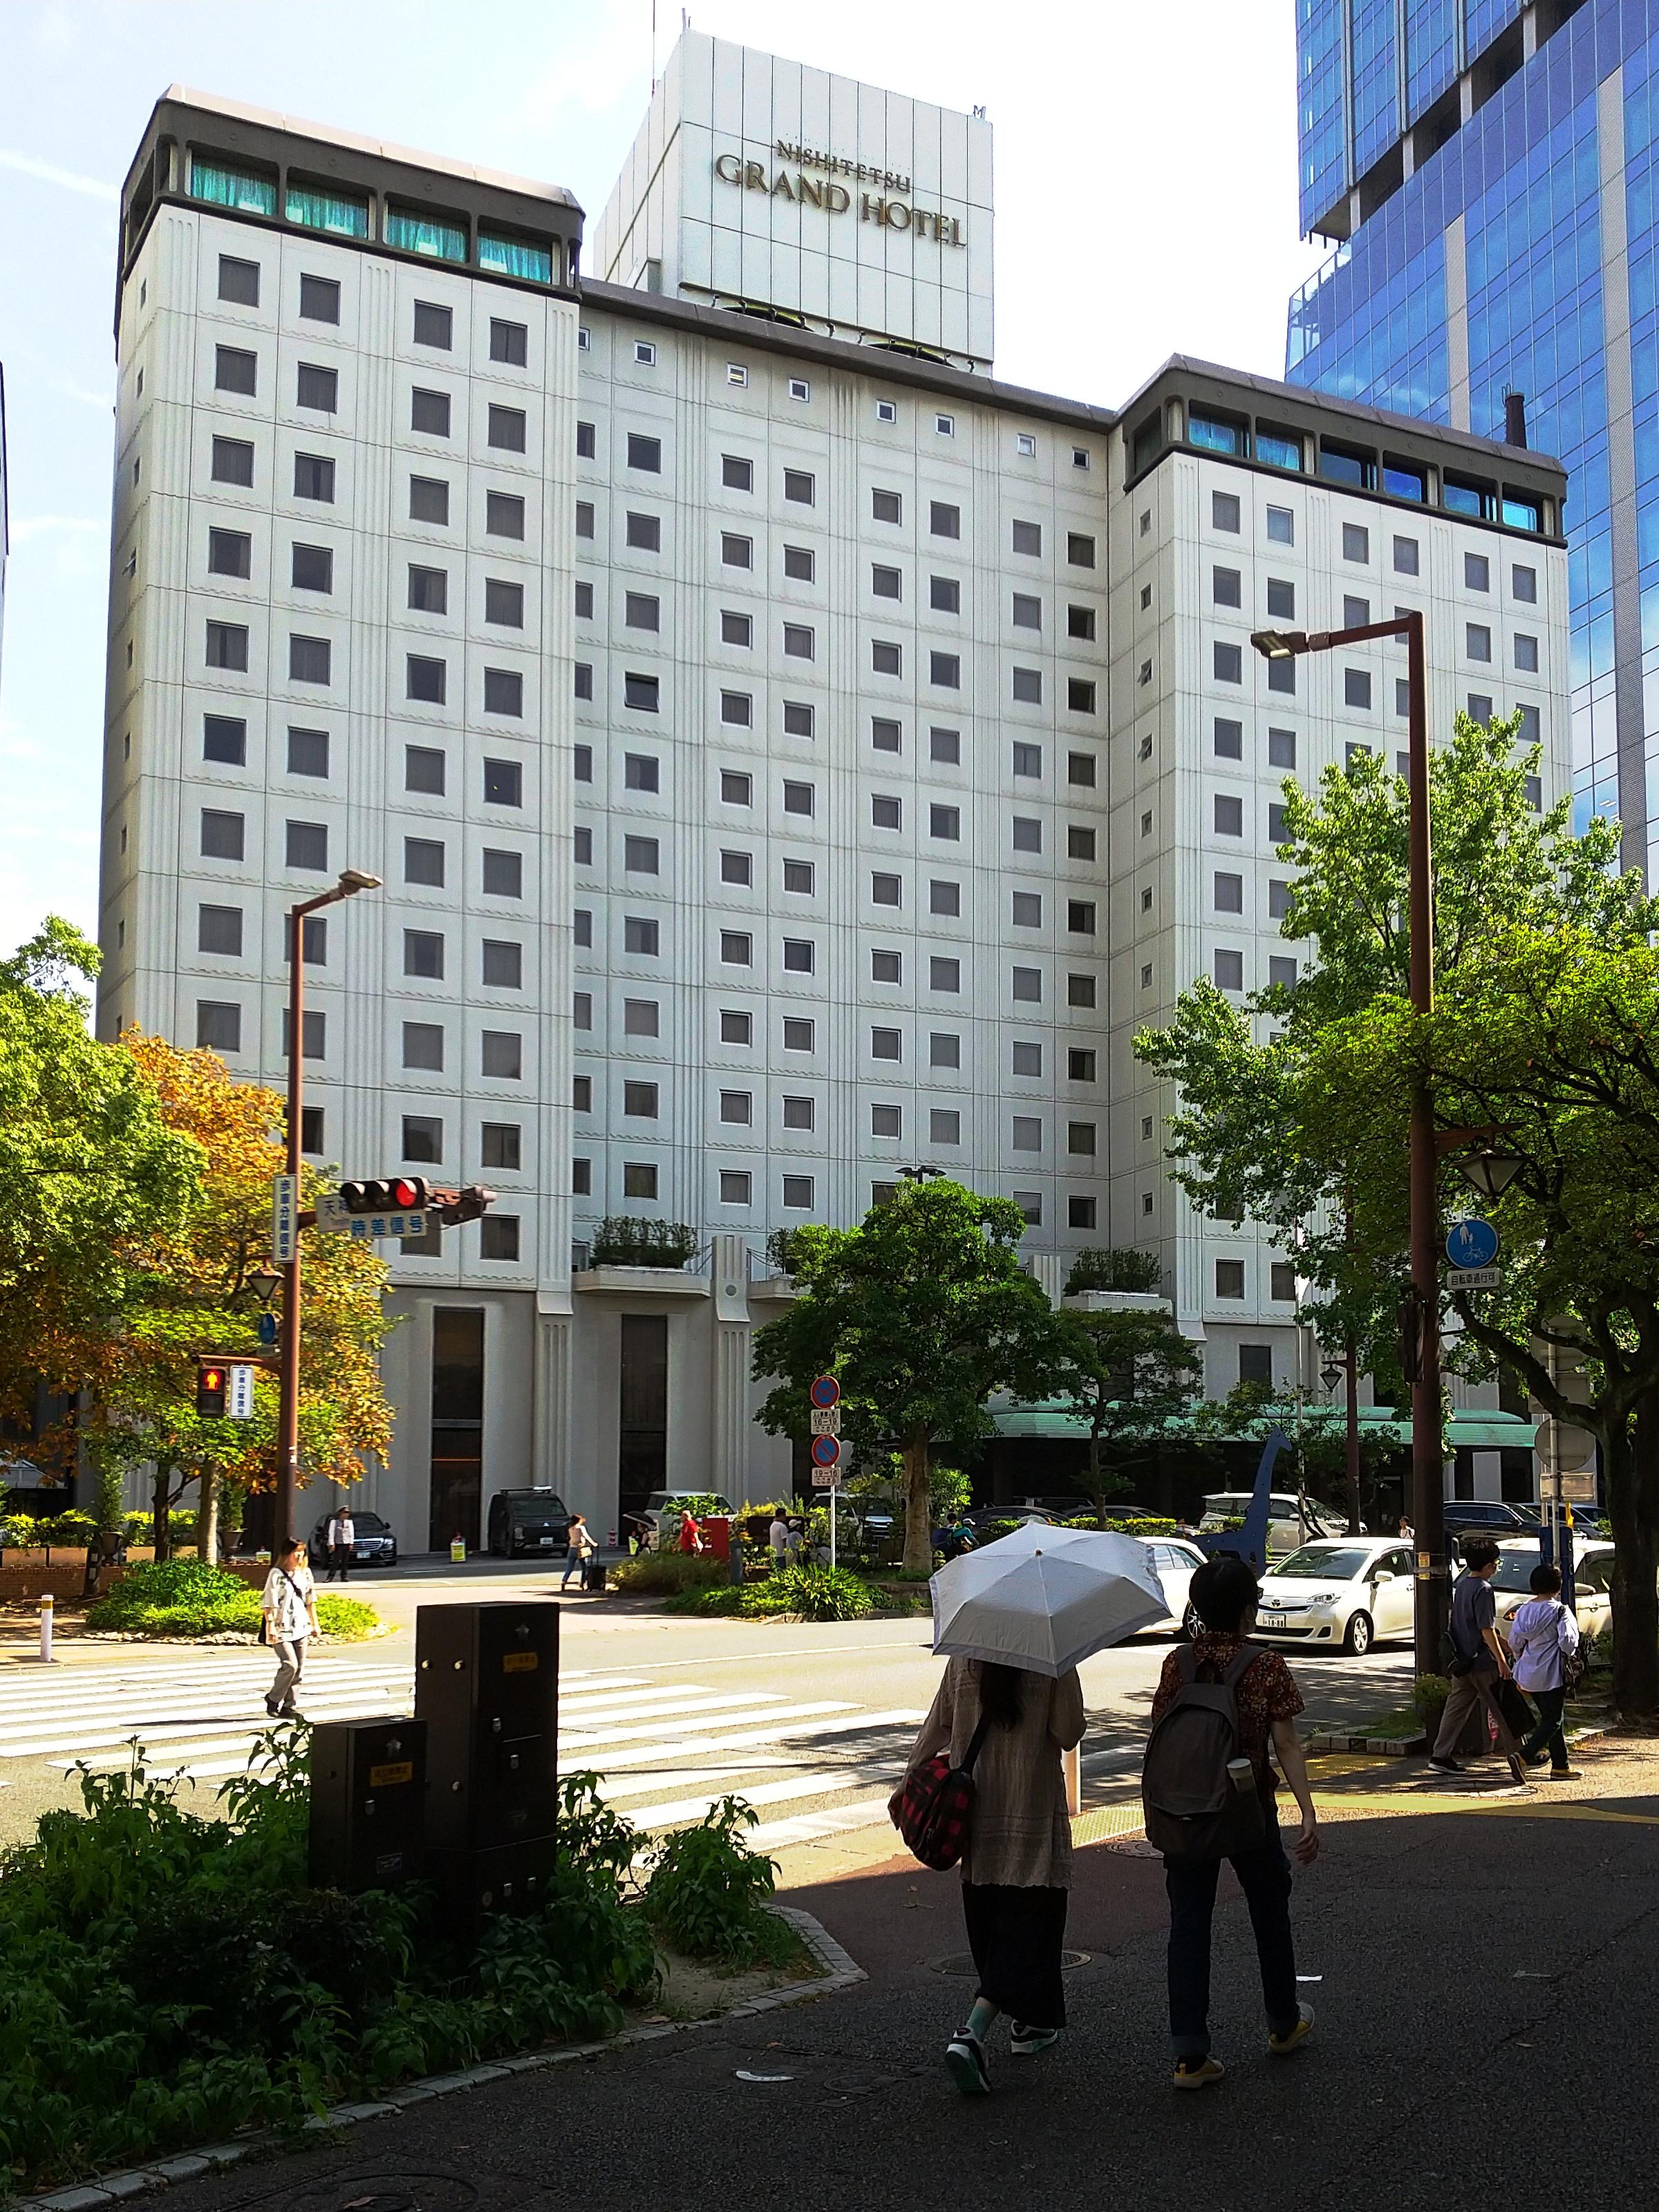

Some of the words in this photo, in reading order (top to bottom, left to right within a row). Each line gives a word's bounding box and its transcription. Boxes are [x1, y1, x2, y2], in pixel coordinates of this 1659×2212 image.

[777, 139, 911, 194] NISHITETSU
[715, 153, 851, 214] GRAND
[861, 192, 967, 247] HOTEL
[351, 1215, 423, 1237] 時差信号
[1452, 1272, 1495, 1286] 自転車通行可
